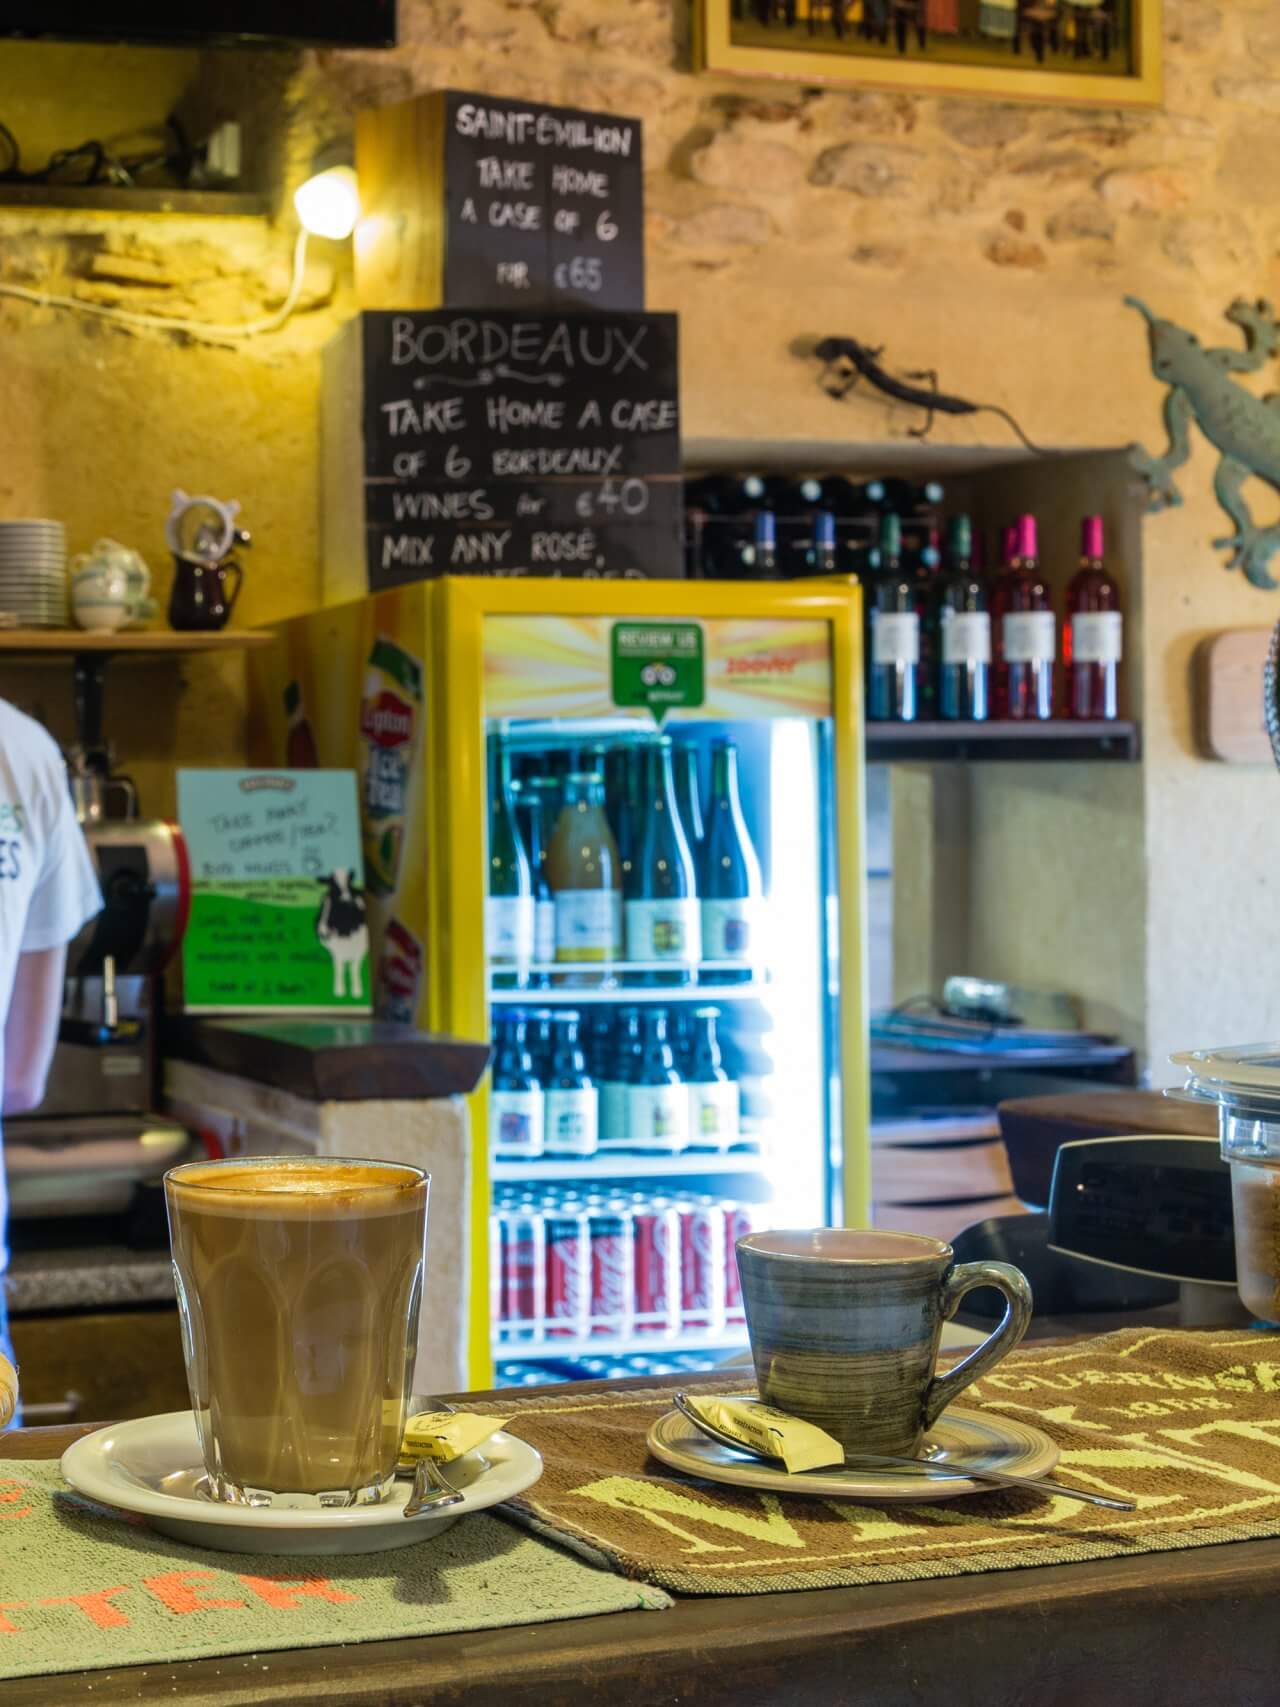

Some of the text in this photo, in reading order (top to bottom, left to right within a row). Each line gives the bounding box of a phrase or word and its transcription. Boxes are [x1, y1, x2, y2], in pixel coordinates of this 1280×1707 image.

[476, 156, 609, 198] TAKE HOME
[460, 198, 619, 242] A CASE OF 6
[496, 261, 531, 290] FOR
[391, 317, 649, 374] BORDEAUX
[381, 395, 678, 436] TAKE HOME A CASE
[392, 445, 624, 479] OF 6 BORDEAUX
[392, 489, 495, 521] WINES
[575, 478, 649, 518] €40
[381, 534, 435, 569] MIX
[450, 529, 512, 563] ANY
[619, 631, 697, 648] REVIEW US
